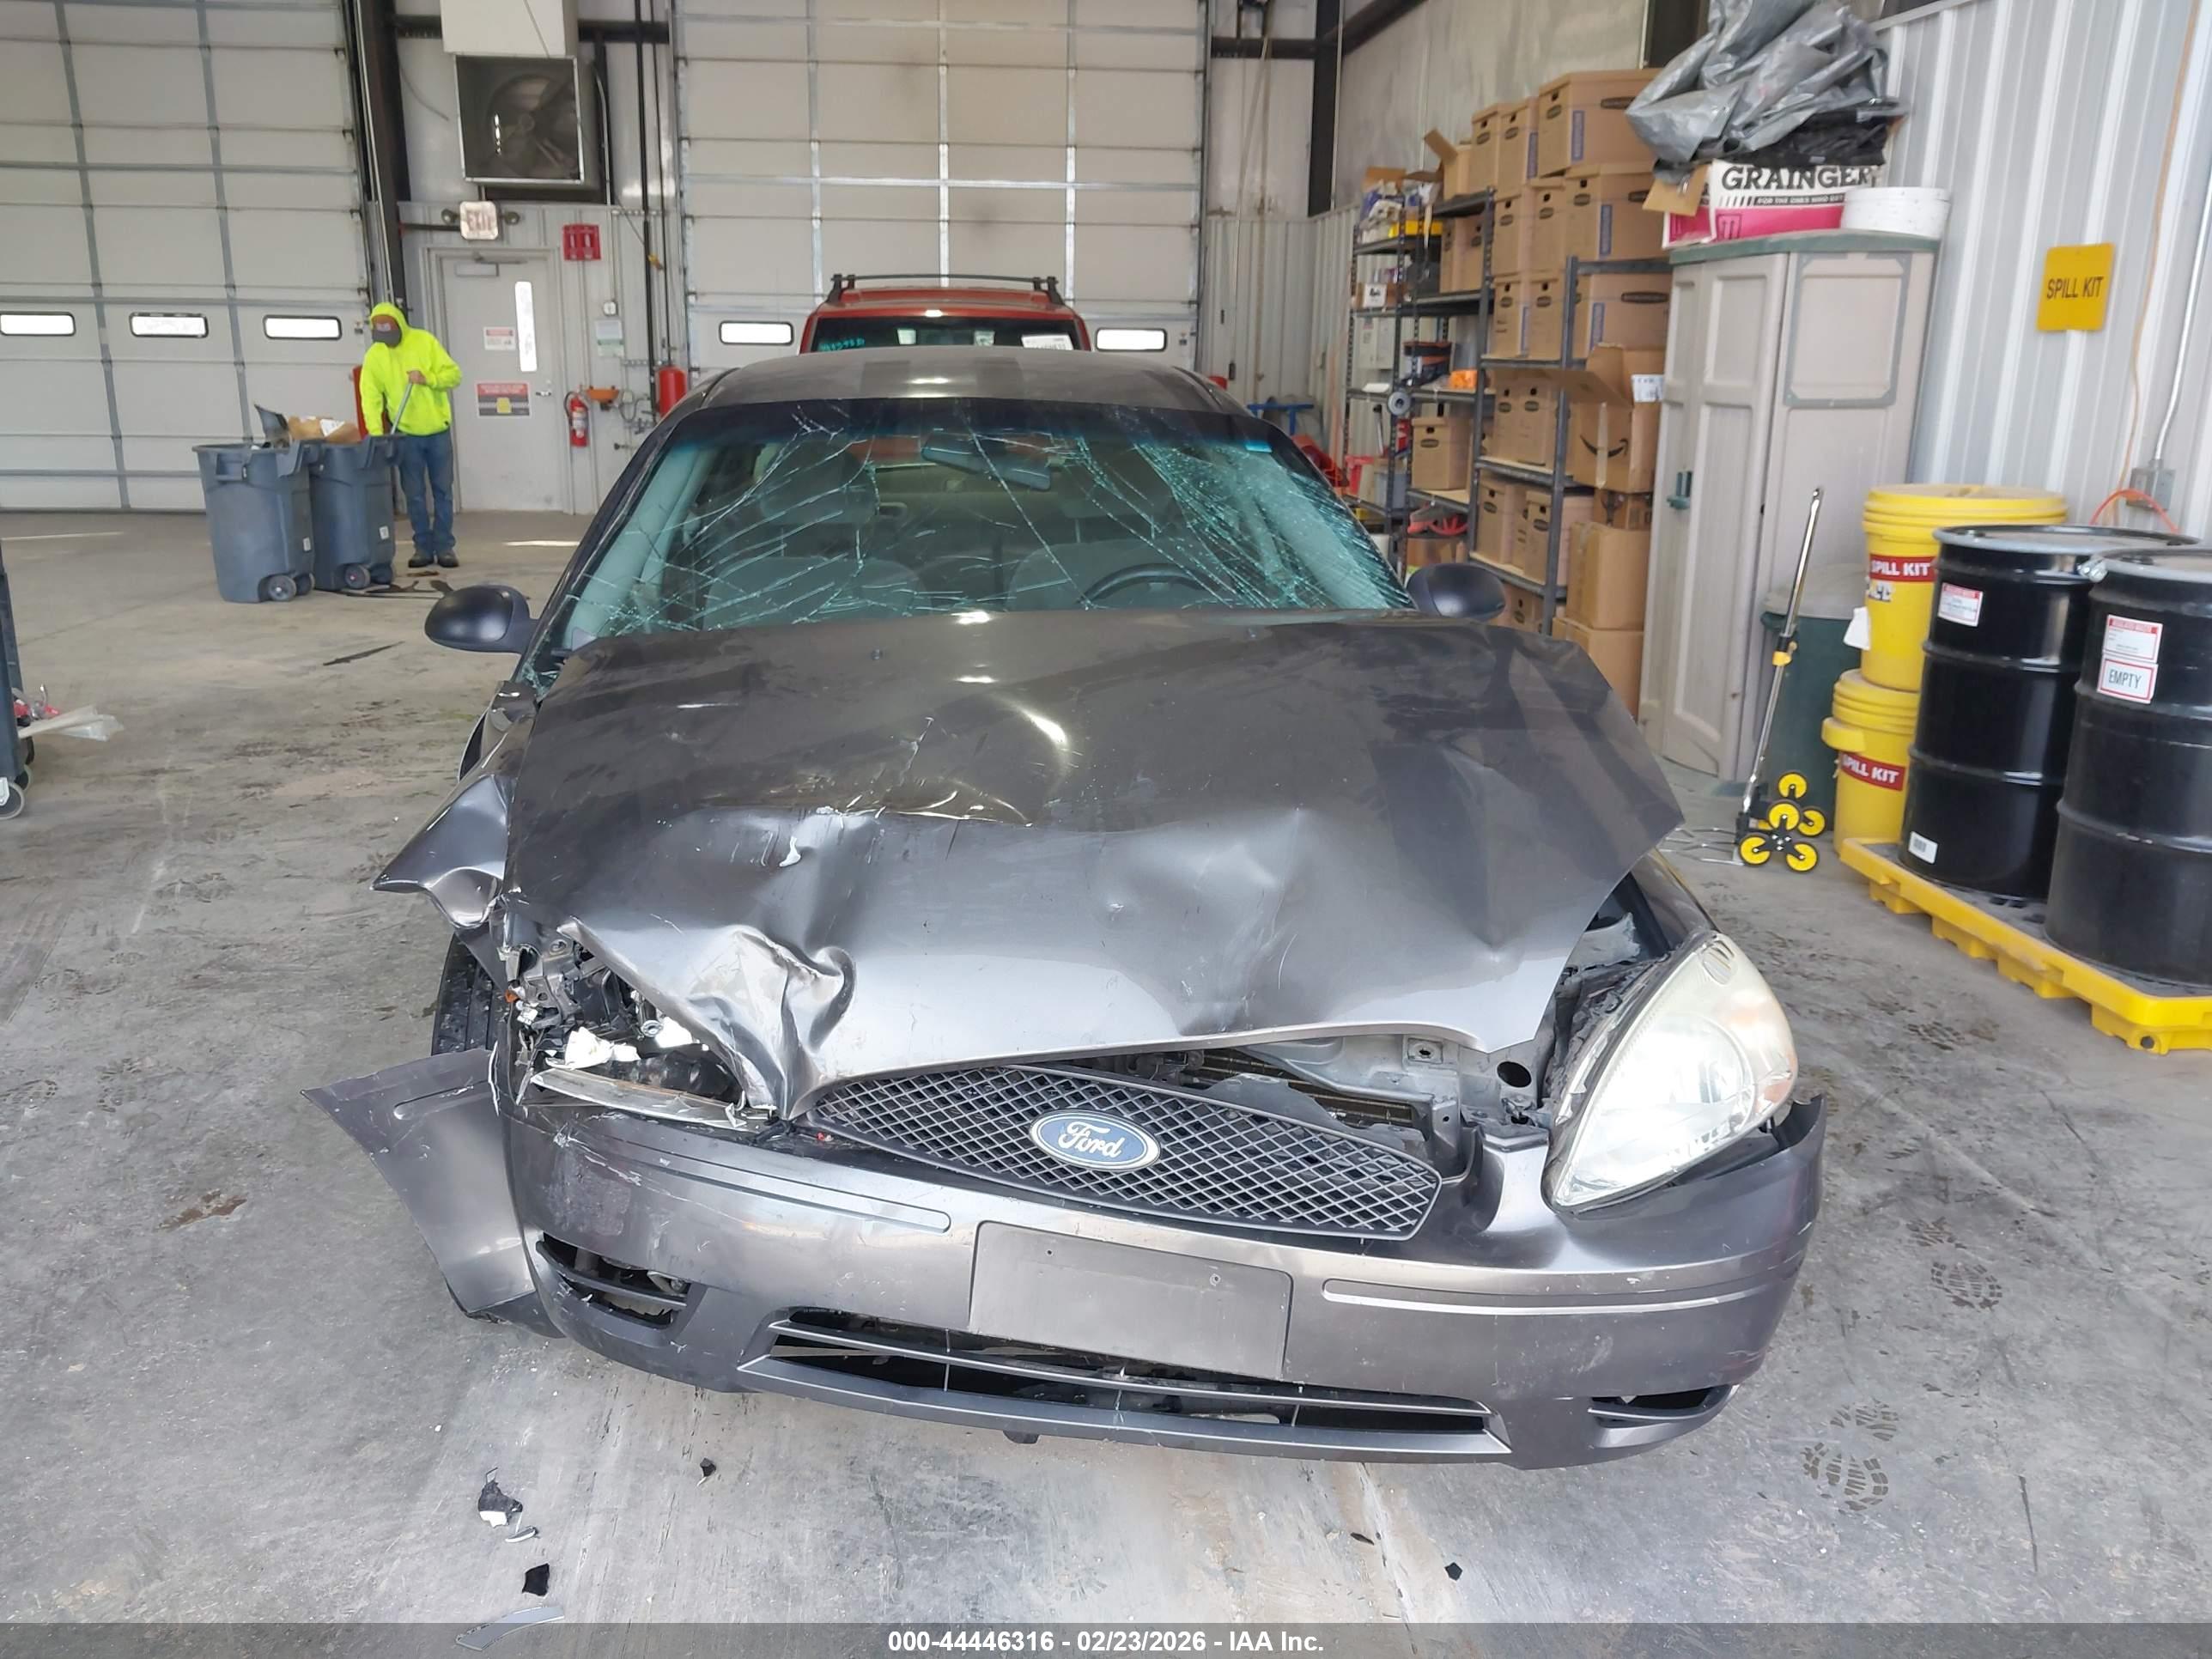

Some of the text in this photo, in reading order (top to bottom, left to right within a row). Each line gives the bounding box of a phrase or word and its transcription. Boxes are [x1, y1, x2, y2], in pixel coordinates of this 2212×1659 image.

[2046, 276, 2104, 299] SPILL KIT
[1903, 562, 1930, 576] KIT
[2108, 669, 2142, 689] EMPTY
[1870, 766, 1899, 783] KIT
[1058, 1121, 1126, 1158] Ford
